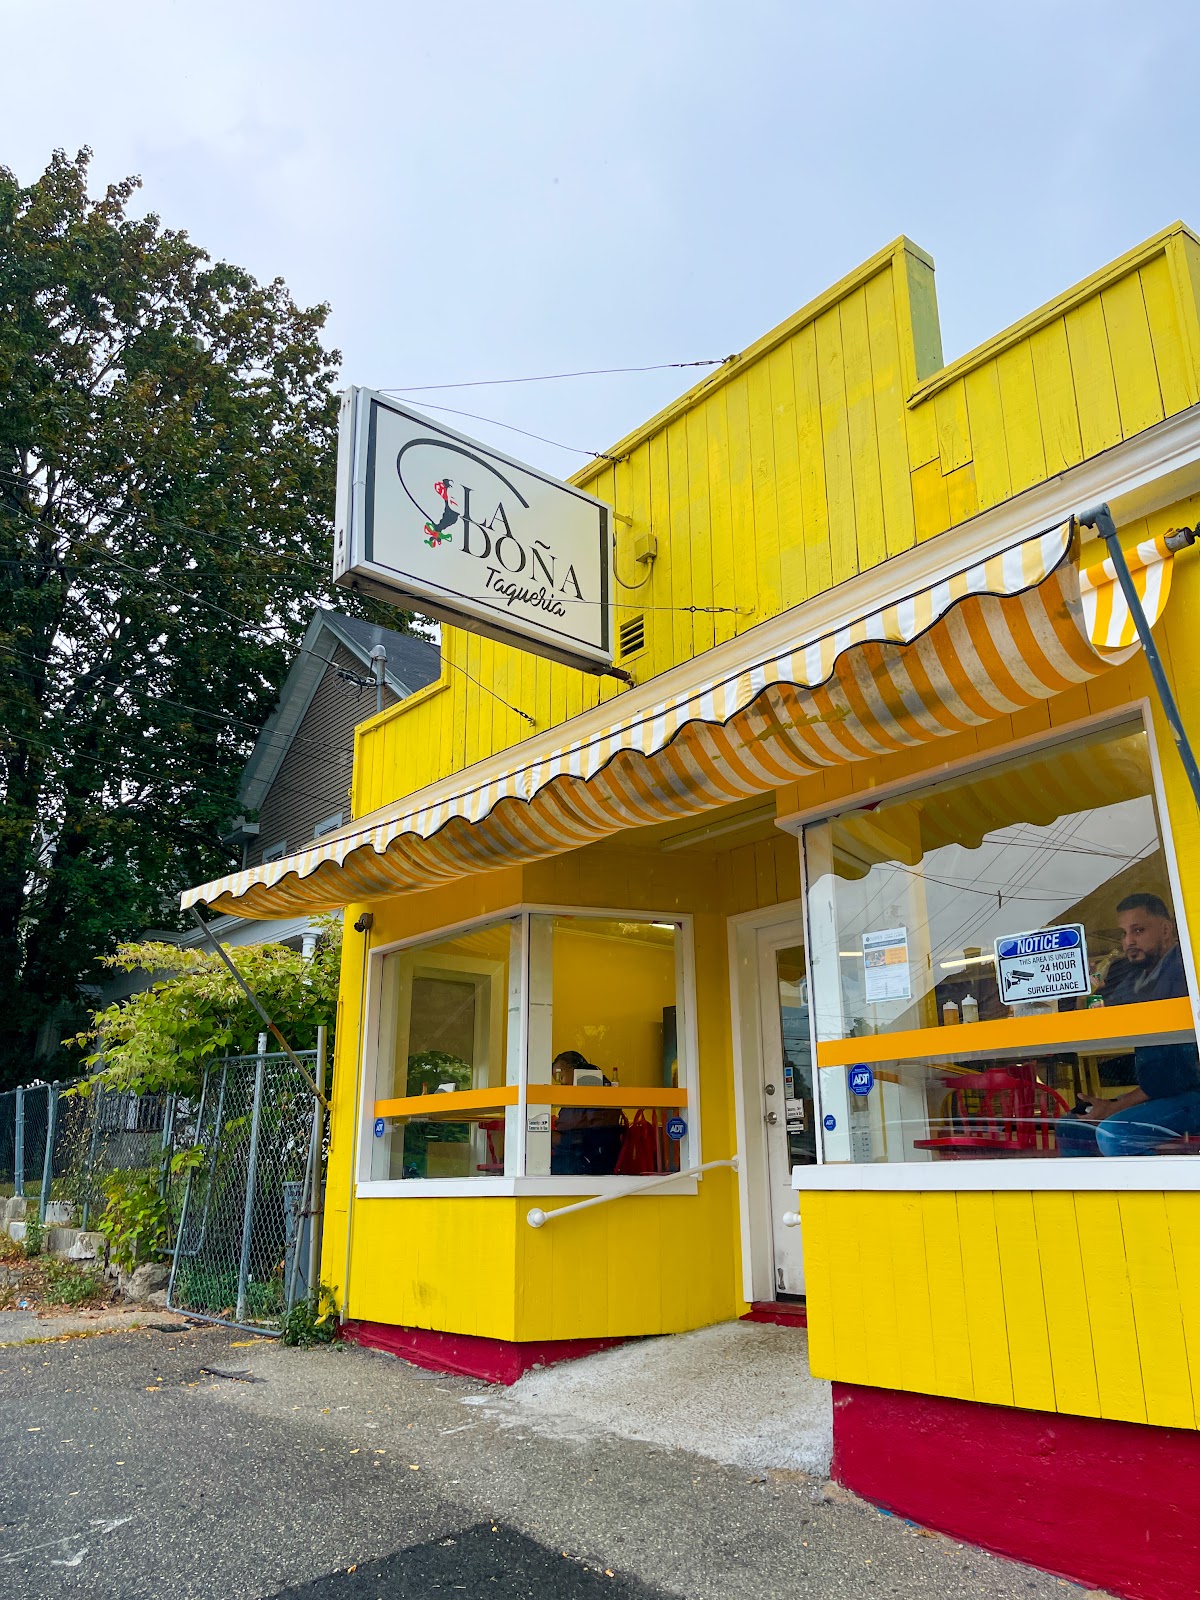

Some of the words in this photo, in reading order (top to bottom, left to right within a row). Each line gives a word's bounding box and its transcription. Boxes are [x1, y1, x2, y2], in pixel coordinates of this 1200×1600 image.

[460, 484, 513, 538] LA
[459, 516, 585, 601] DOÑA
[485, 565, 566, 618] Taqueria
[1017, 934, 1059, 954] NOTICE
[1019, 957, 1032, 966] THIS
[1032, 956, 1048, 964] AREA
[1048, 954, 1055, 962] IS
[1055, 951, 1076, 961] UNDER
[1040, 963, 1051, 973] 24
[1053, 959, 1077, 971] HOUR
[1046, 972, 1072, 983] VIDEO
[1027, 981, 1079, 995] SURVEILLANCE
[852, 1073, 870, 1086] ADT
[669, 1124, 684, 1133] ADT
